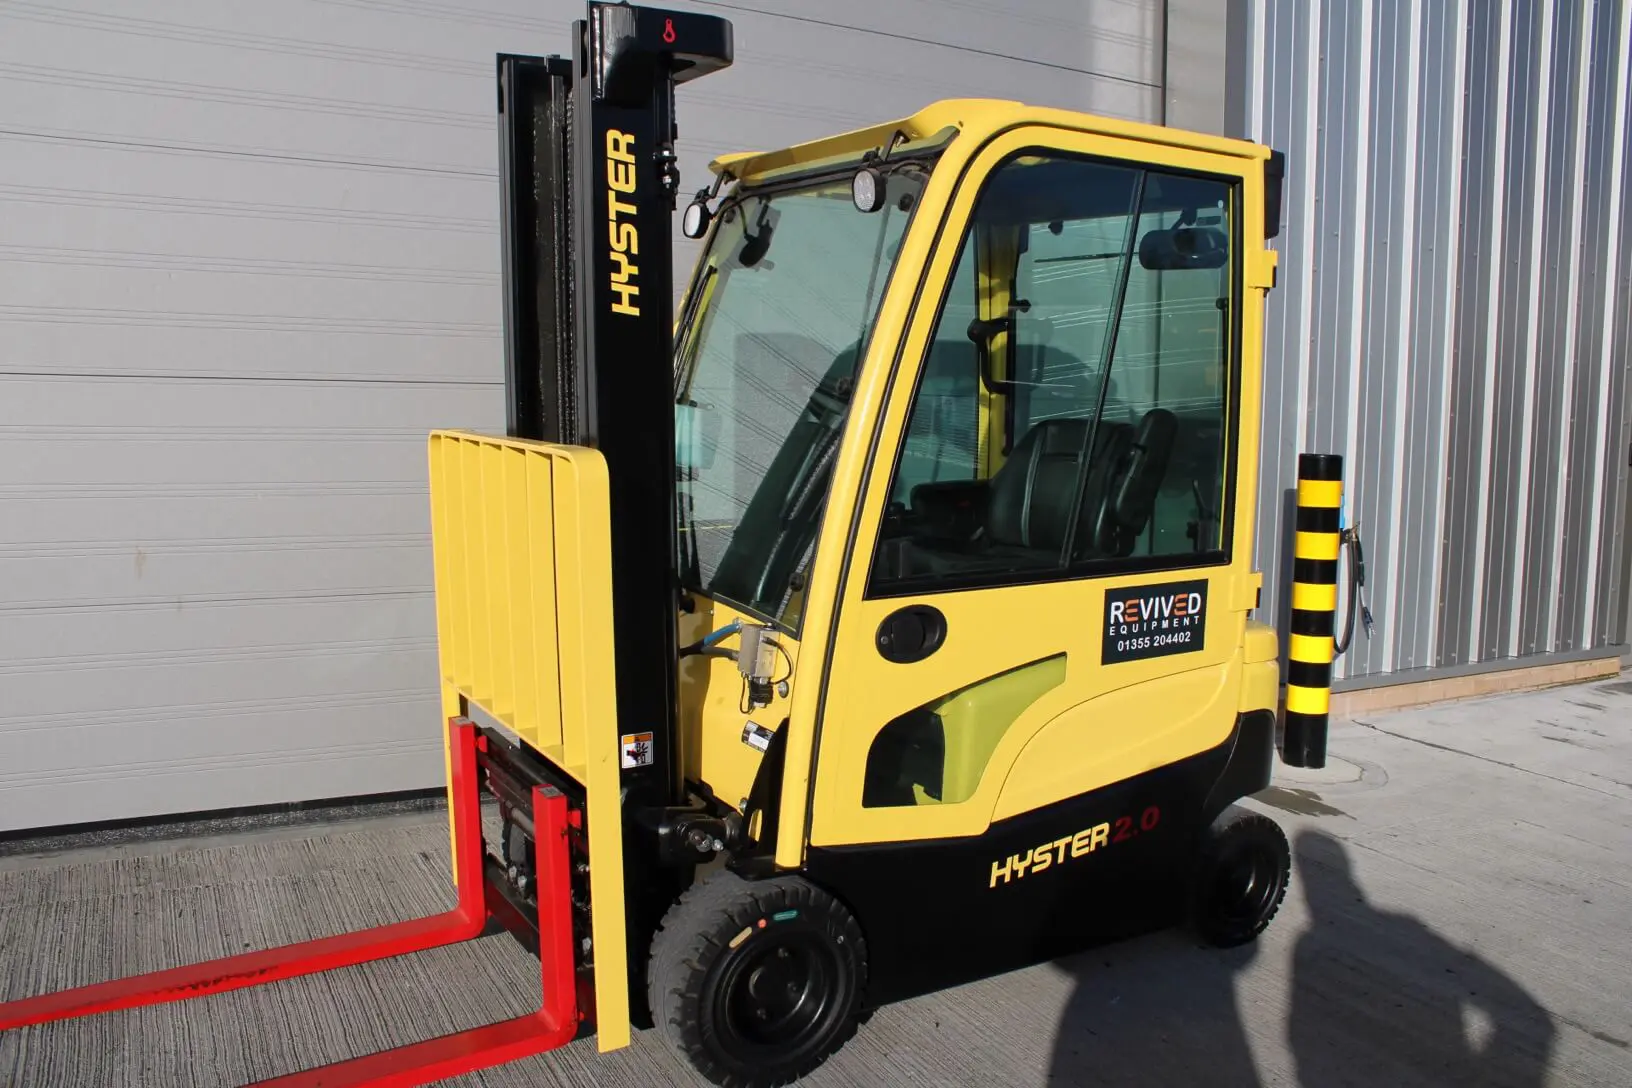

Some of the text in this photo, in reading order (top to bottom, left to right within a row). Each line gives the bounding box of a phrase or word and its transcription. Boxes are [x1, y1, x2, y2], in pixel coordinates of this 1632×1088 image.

[606, 128, 640, 316] HYSTER
[1110, 592, 1201, 624] REVIVED
[1109, 615, 1200, 636] EQUIPMENT
[1117, 631, 1191, 652] 01355 204402
[989, 805, 1160, 888] HYSTER 2.0
